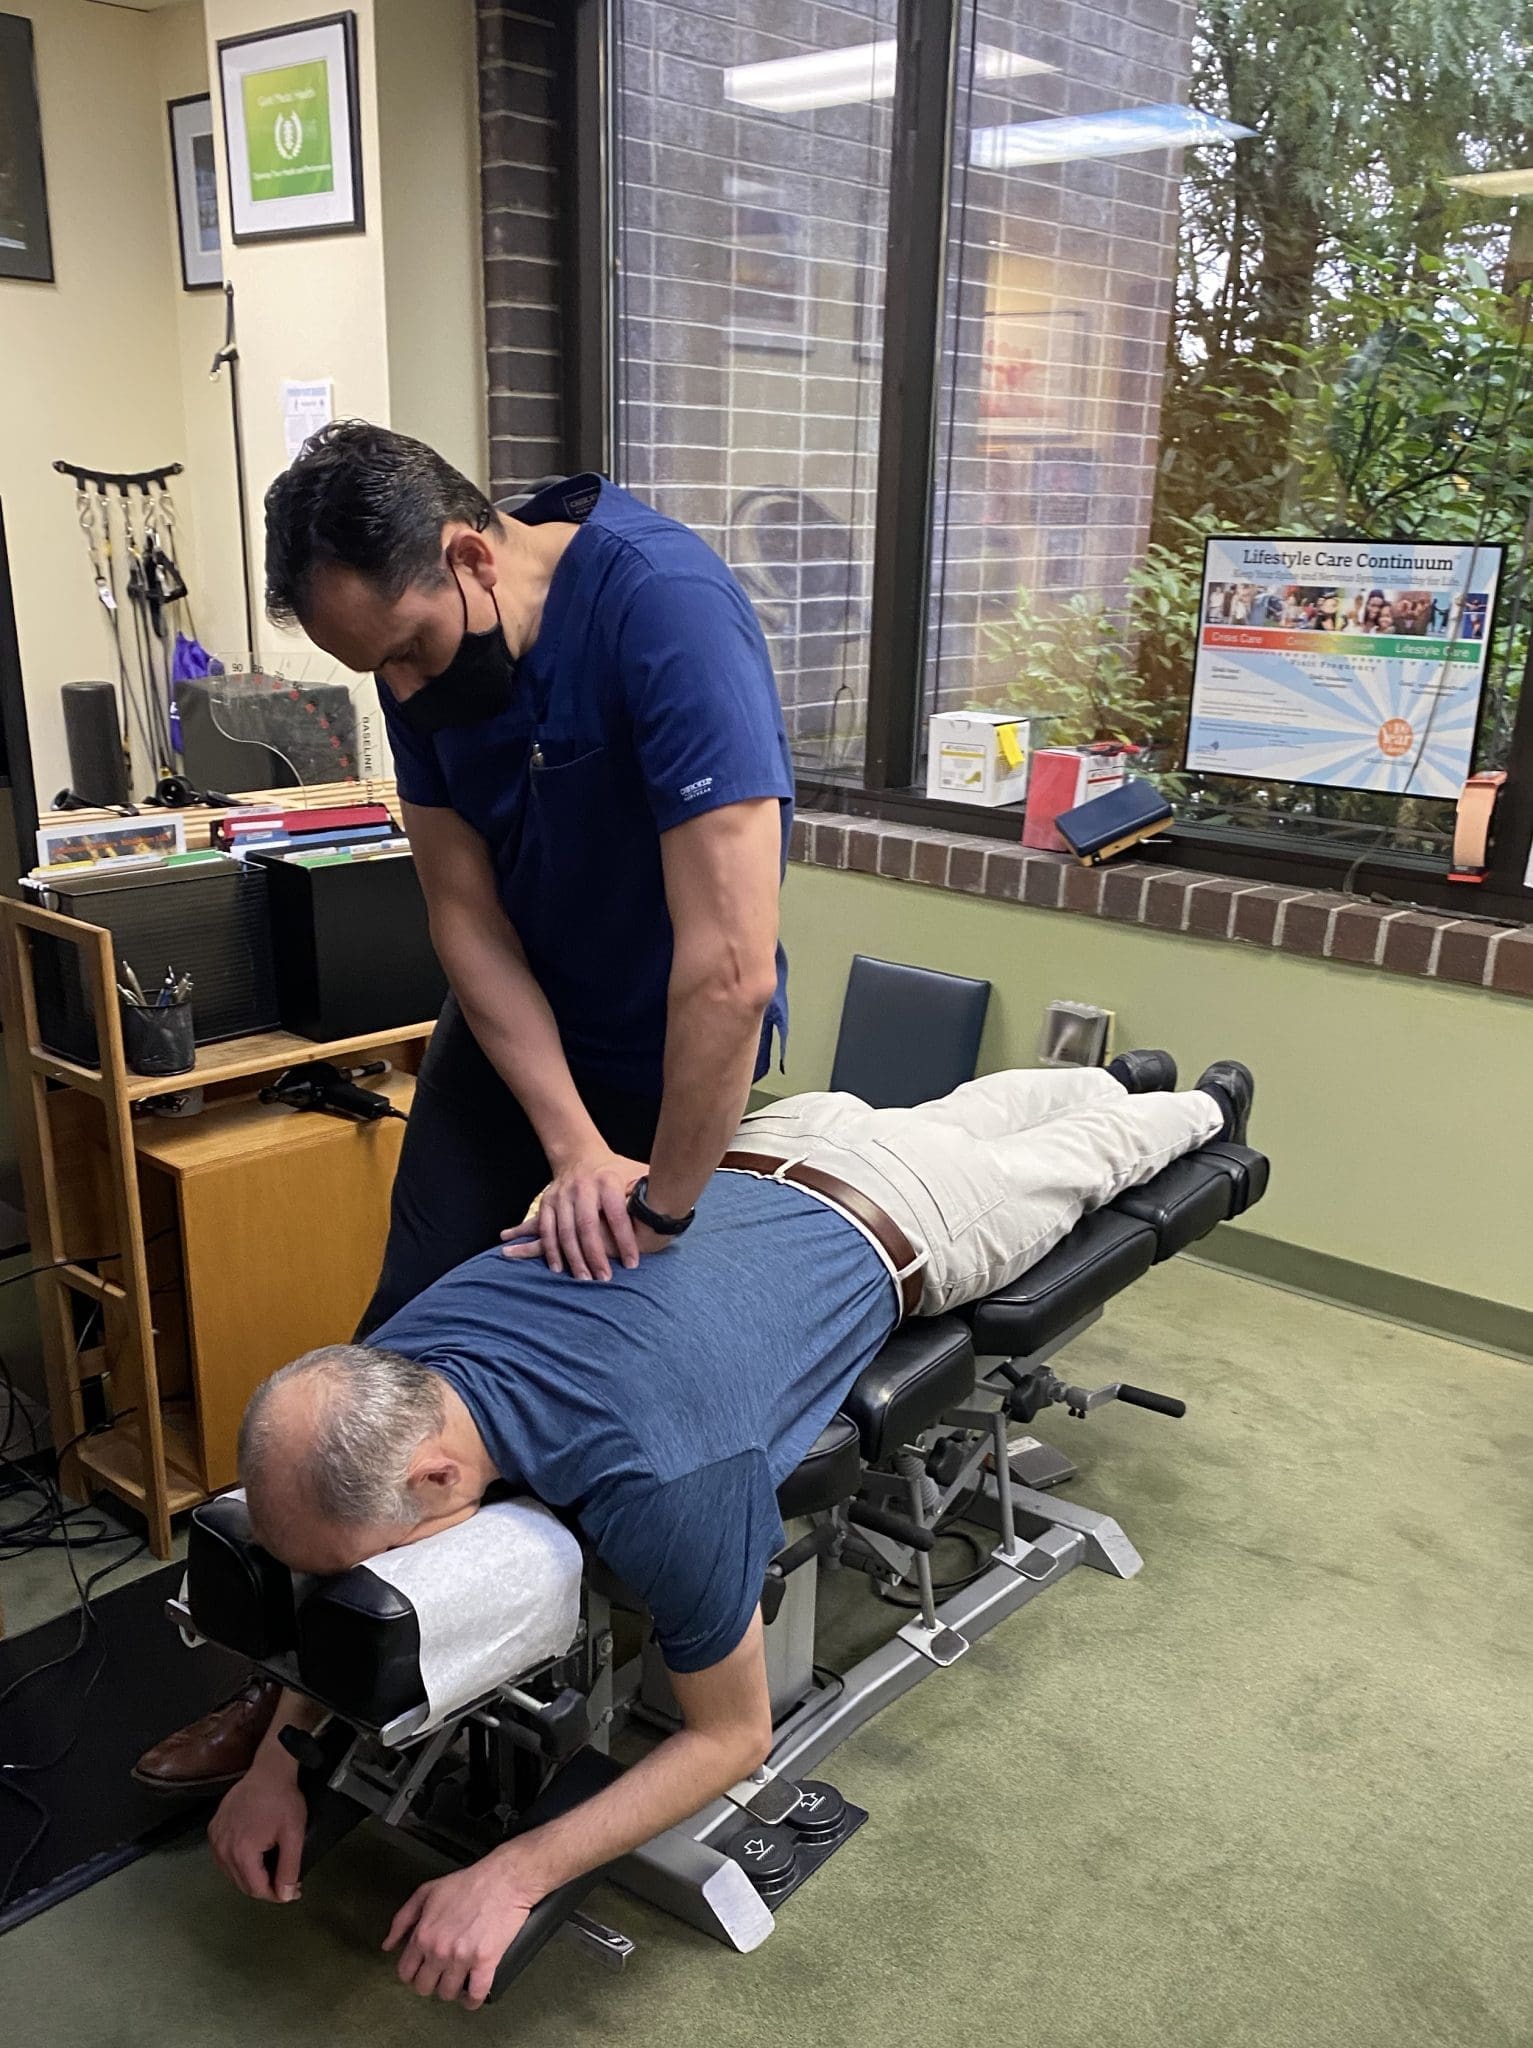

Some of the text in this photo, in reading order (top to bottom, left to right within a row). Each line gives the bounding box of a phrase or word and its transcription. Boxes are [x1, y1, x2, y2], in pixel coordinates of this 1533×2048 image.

[1243, 549, 1453, 570] Lifestyle Care Continuum
[1240, 634, 1264, 644] Care
[1395, 643, 1440, 657] Lifestyle
[232, 663, 243, 673] 90
[362, 716, 374, 803] BASELINE JOIN
